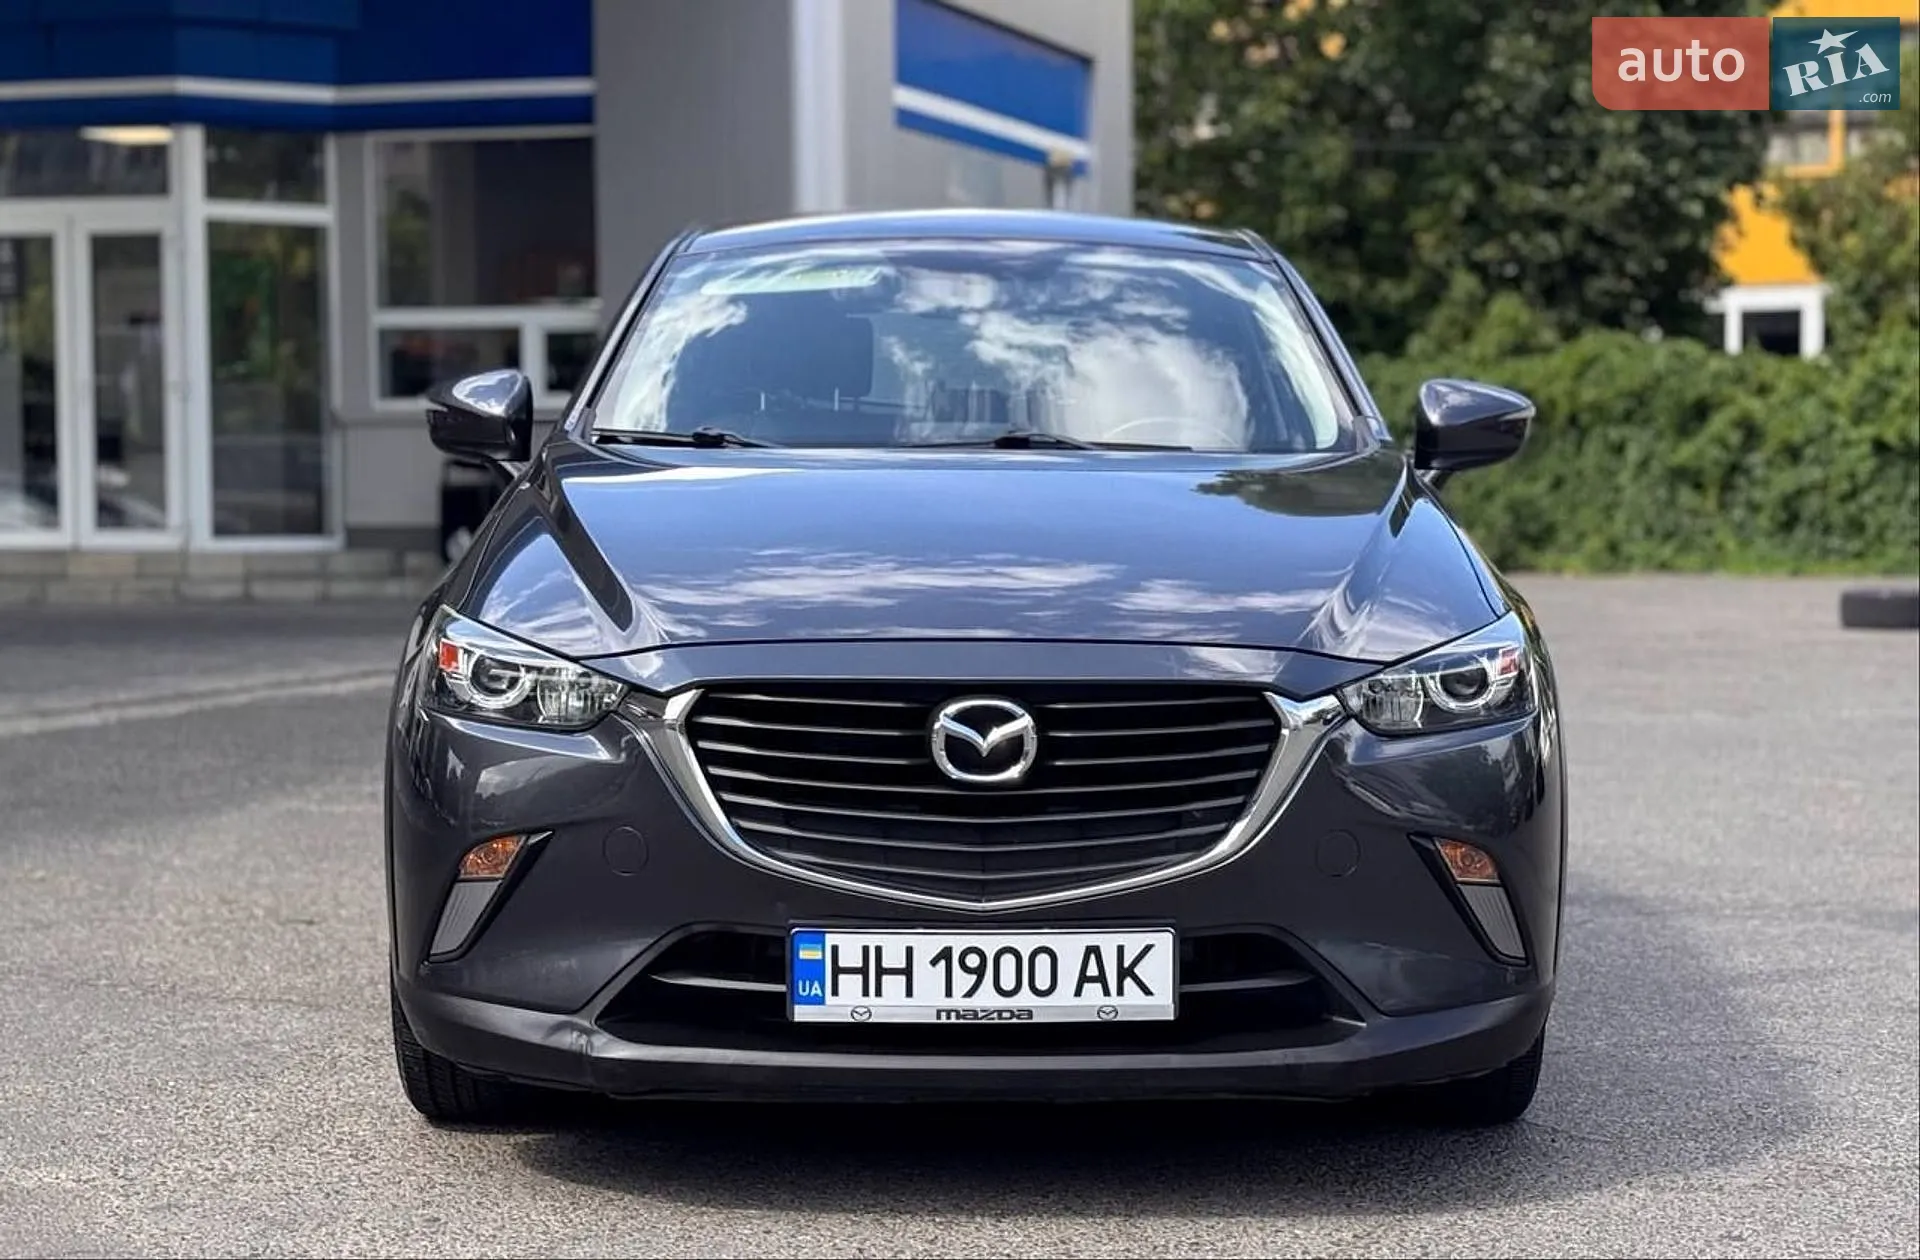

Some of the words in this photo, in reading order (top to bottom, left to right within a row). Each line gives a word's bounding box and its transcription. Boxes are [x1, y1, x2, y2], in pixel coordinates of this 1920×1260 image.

[830, 944, 914, 998] HH
[929, 944, 1059, 998] 1900
[1073, 943, 1156, 997] AK
[798, 982, 823, 997] UA
